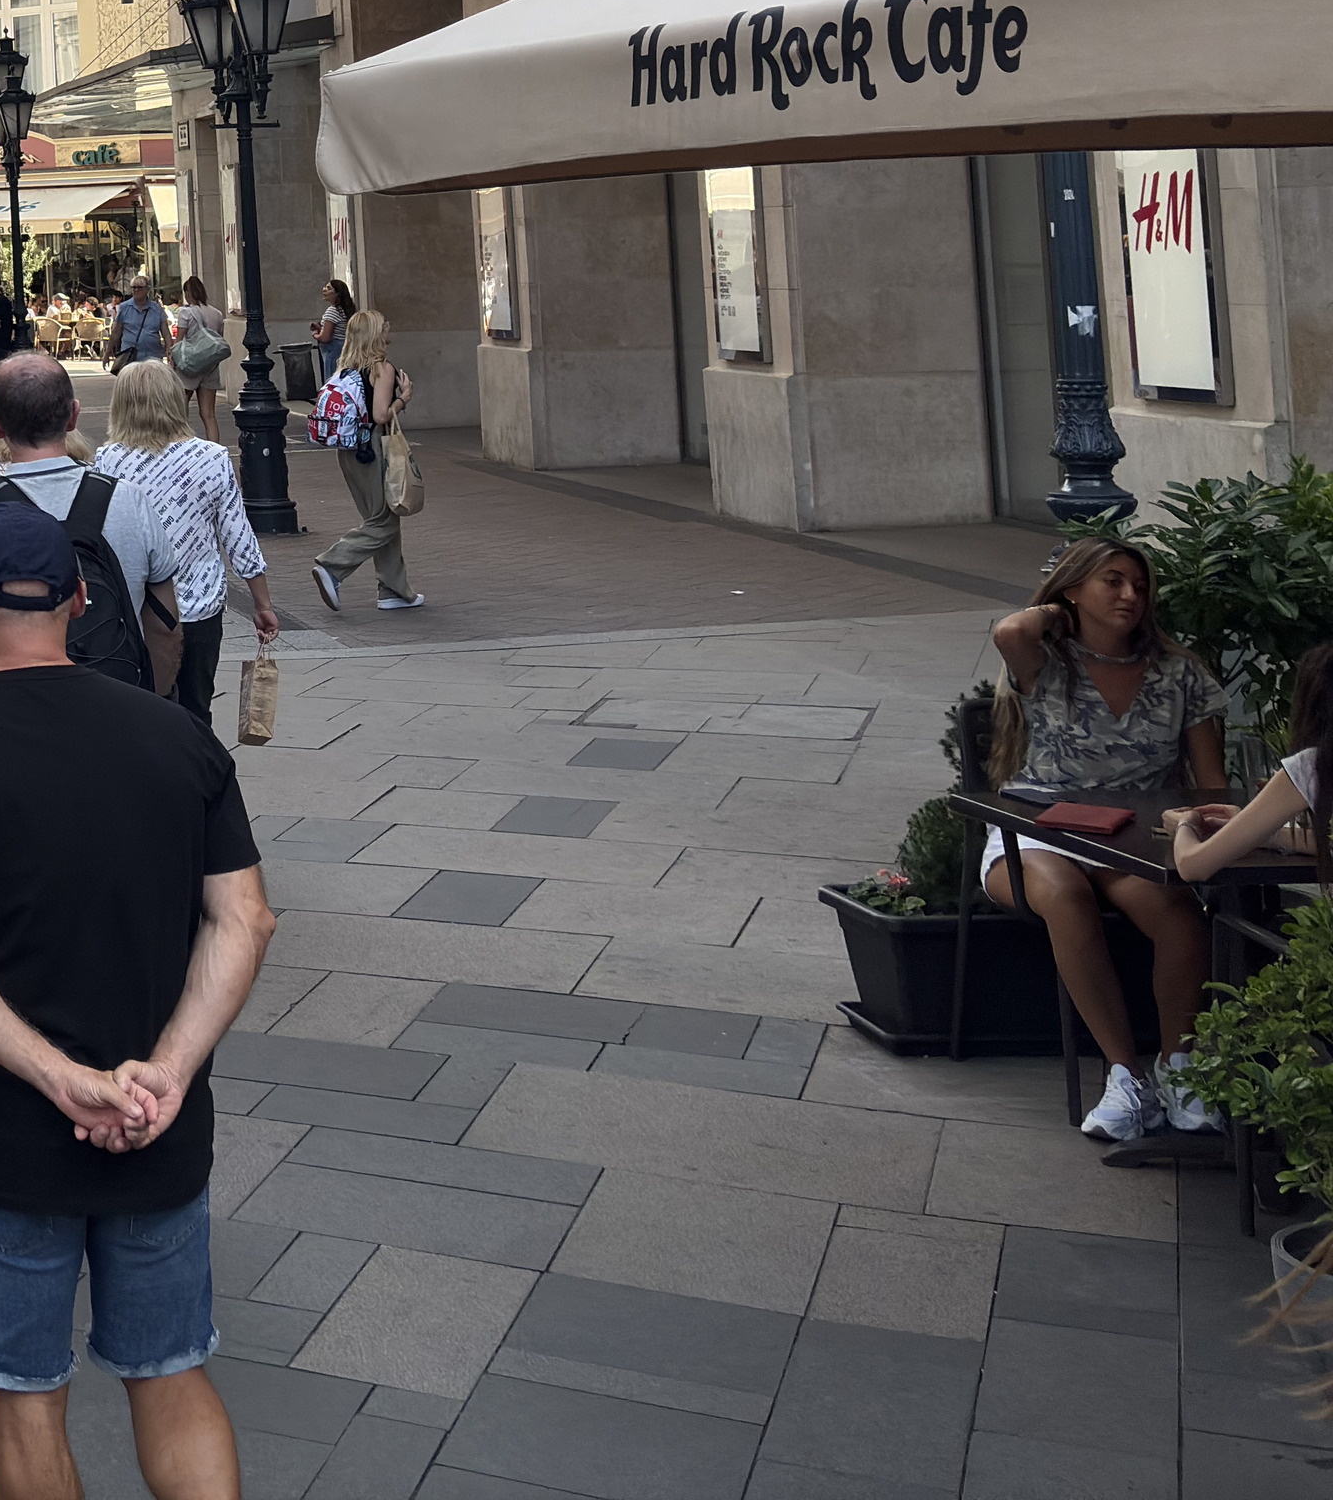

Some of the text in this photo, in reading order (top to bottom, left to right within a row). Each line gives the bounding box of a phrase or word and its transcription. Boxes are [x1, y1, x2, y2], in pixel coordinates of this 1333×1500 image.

[628, 10, 748, 107] Hard
[72, 143, 121, 166] café
[1132, 169, 1194, 254] H&M
